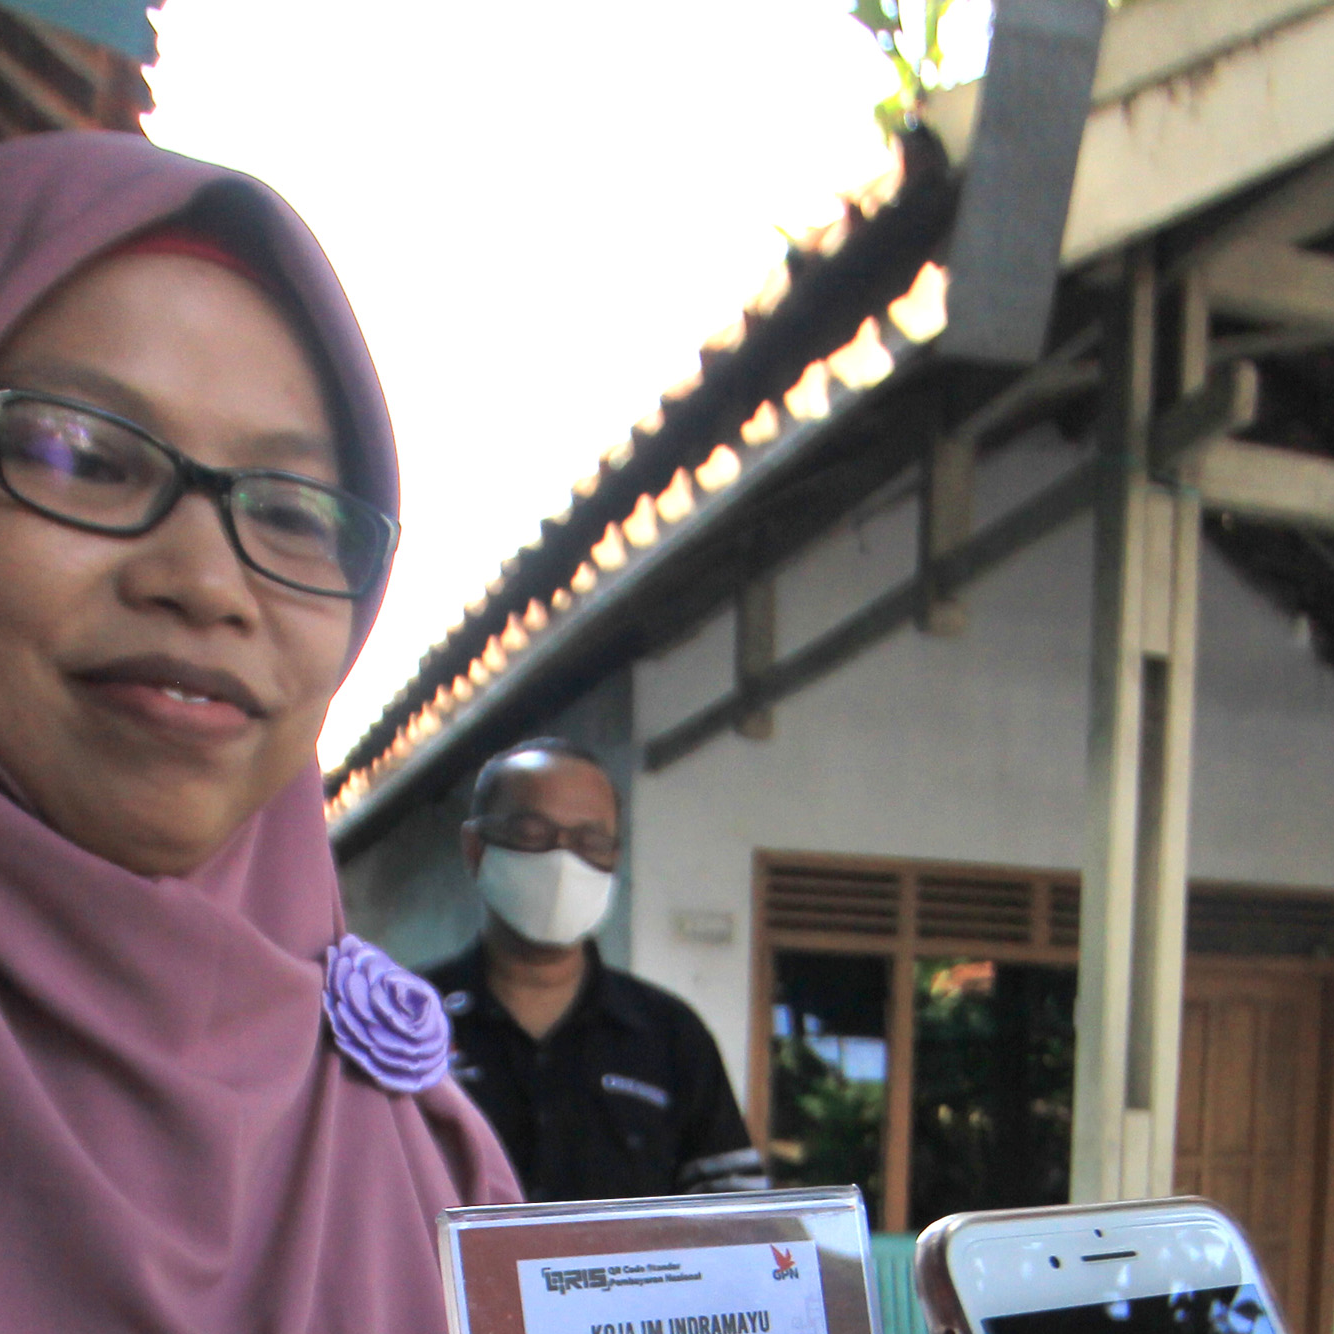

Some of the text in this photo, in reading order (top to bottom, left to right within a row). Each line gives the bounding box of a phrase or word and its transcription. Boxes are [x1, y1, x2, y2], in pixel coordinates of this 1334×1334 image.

[608, 1266, 621, 1275] QR
[623, 1265, 645, 1274] Code
[772, 1267, 799, 1281] GPN
[543, 1267, 609, 1294] QRIS
[665, 1272, 703, 1282] Nasional
